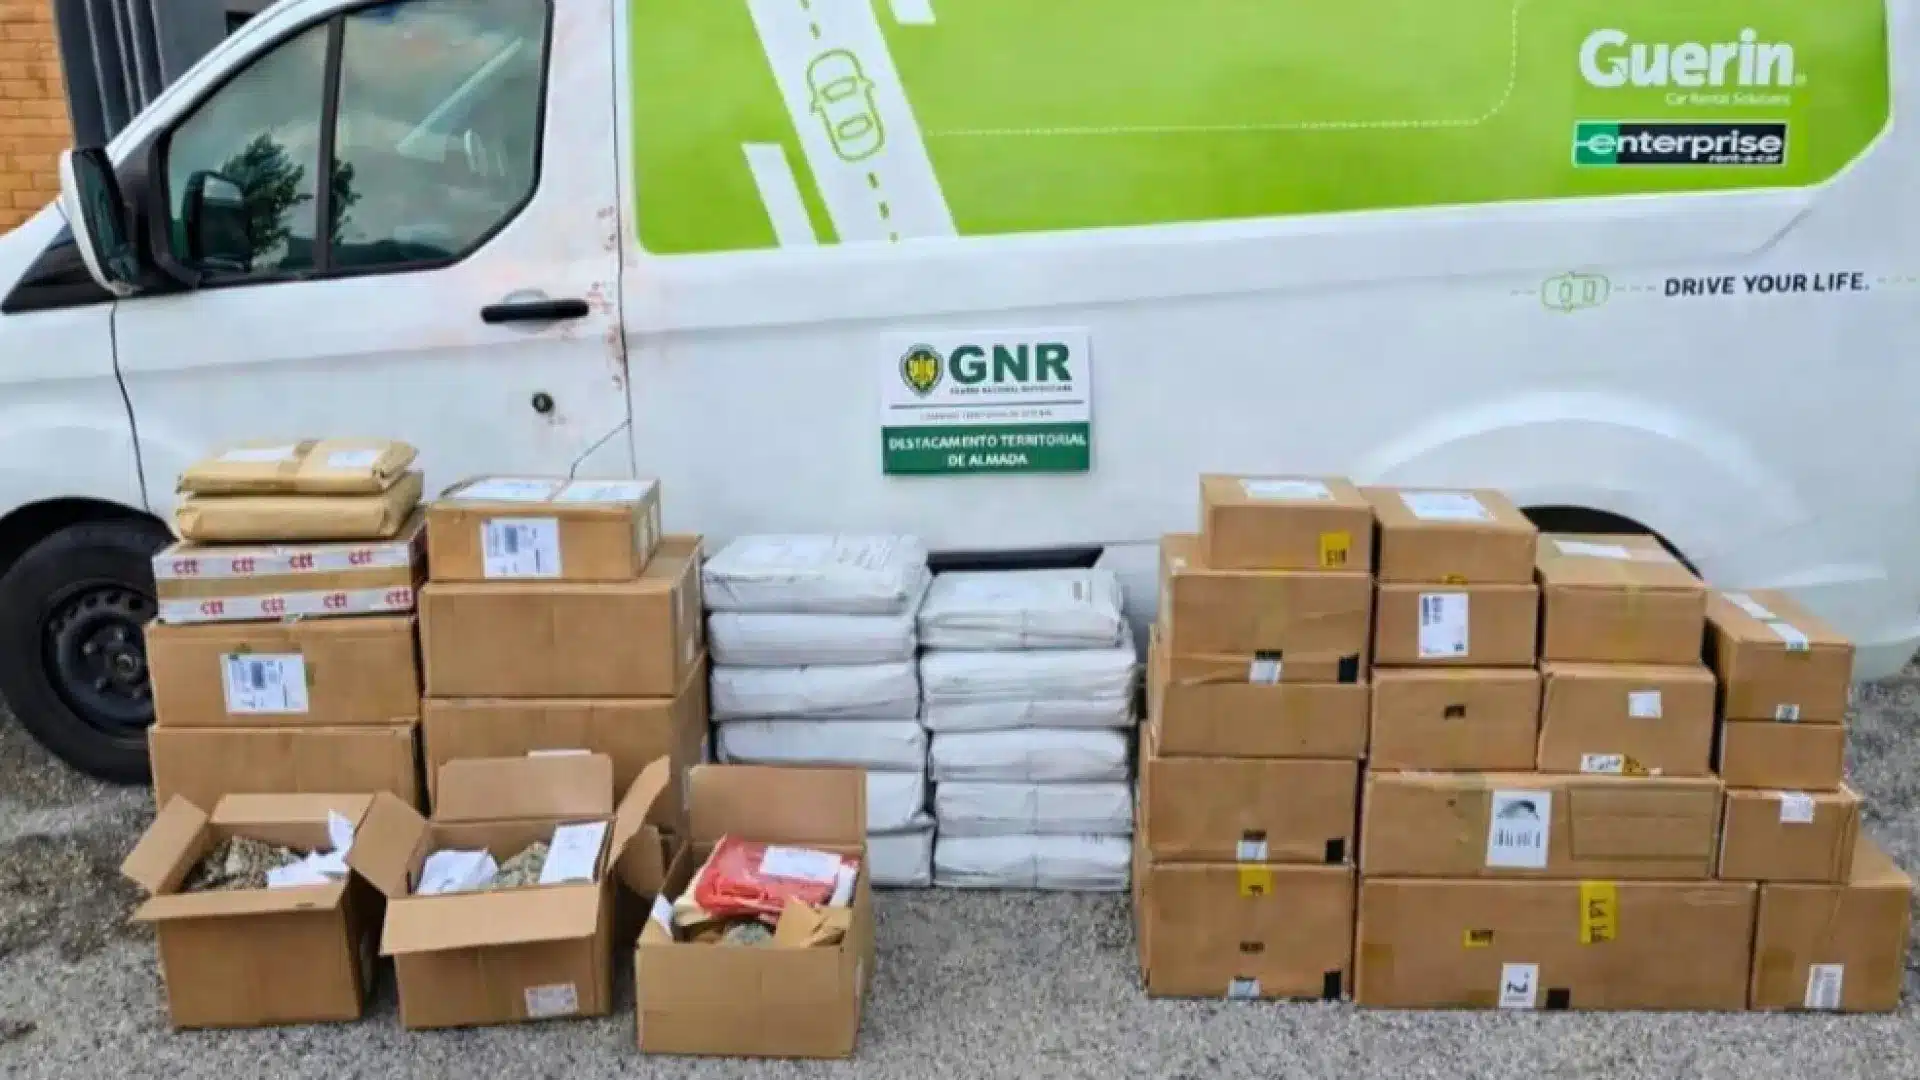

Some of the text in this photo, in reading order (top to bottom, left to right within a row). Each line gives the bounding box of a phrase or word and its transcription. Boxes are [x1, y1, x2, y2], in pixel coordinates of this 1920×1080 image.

[1579, 28, 1794, 87] Guerin
[1586, 129, 1782, 160] enterprise
[1708, 154, 1781, 164] rent-a-car
[1664, 272, 1870, 296] DRIVE YOUR LIFE.
[949, 342, 1072, 384] GNR
[888, 431, 1087, 451] DESTACAMENTO TERRITORIAL
[947, 452, 1028, 467] DE ALMADA
